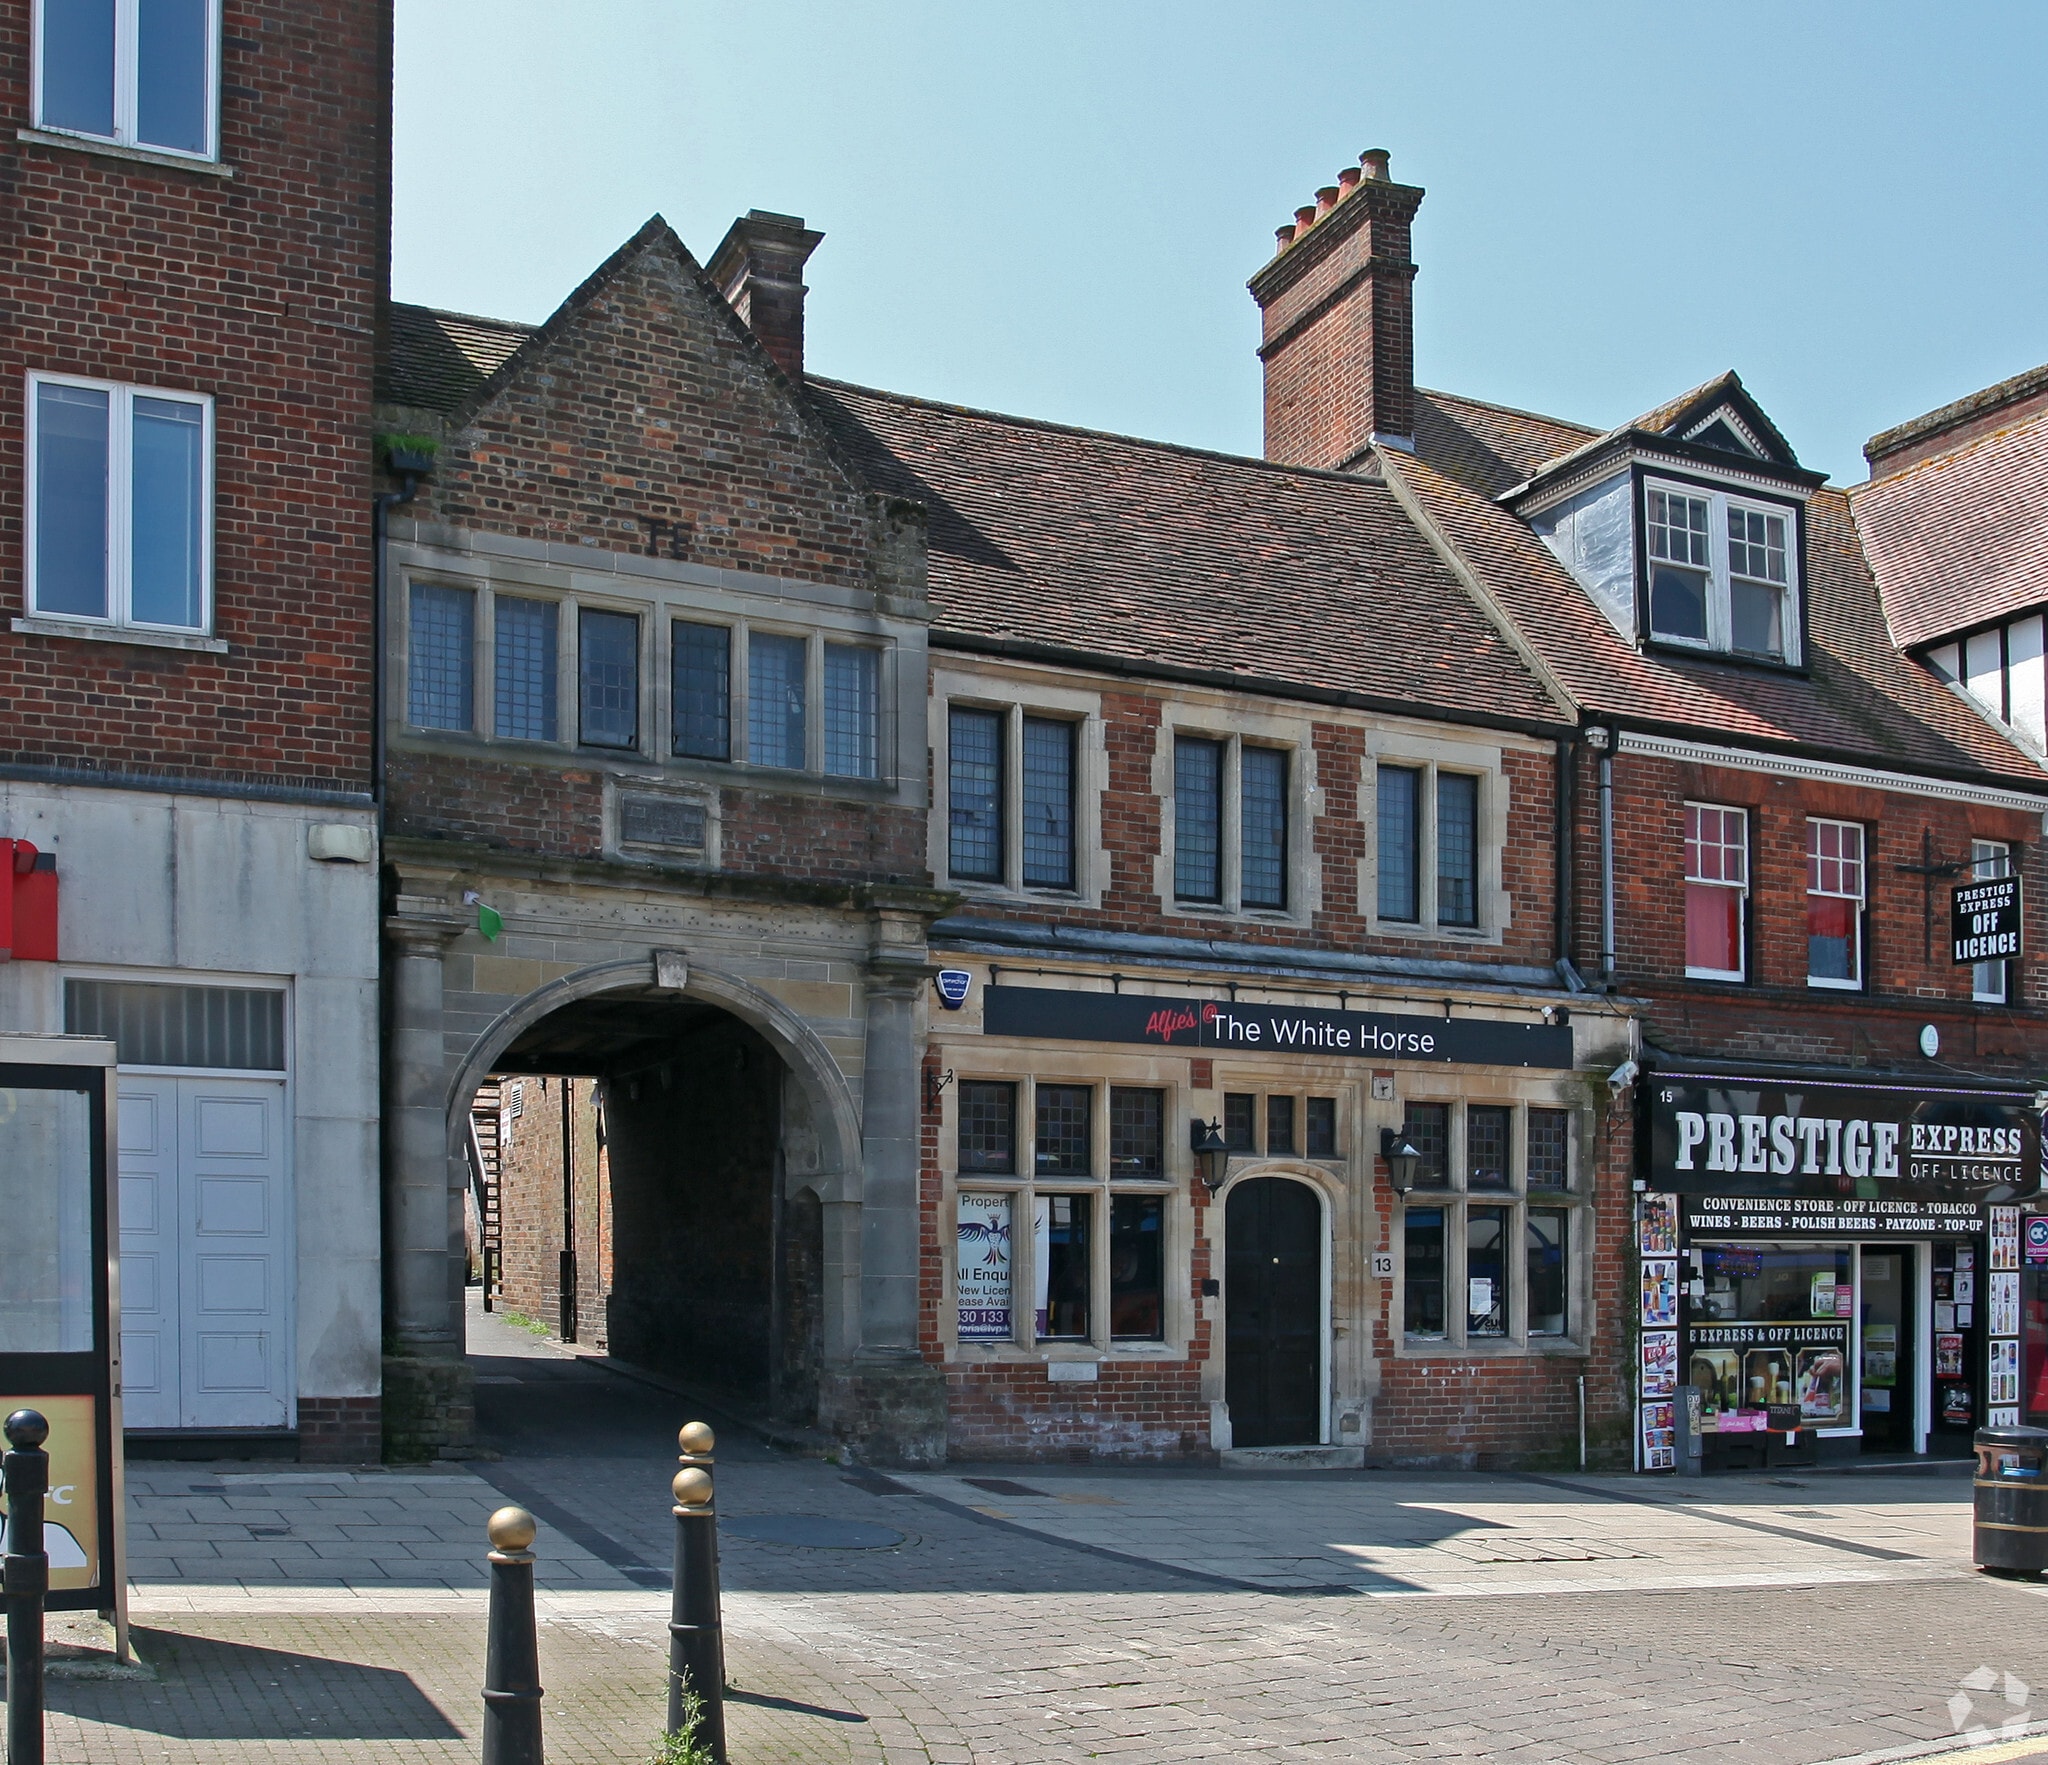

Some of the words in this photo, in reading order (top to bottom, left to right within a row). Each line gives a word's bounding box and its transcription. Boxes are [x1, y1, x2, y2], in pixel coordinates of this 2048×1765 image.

[1957, 883, 2014, 902] PRESTIGE
[1960, 896, 2010, 913] EXPRESS
[1972, 911, 1999, 935] OFF
[1955, 931, 2017, 960] LICENCE
[1145, 1005, 1198, 1042] Alfie's
[1211, 1014, 1261, 1042] The
[1270, 1018, 1351, 1048] White
[1360, 1024, 1435, 1053] Horse
[1660, 1091, 1673, 1103] 15
[1674, 1111, 1900, 1178] PRESTIGE
[1910, 1124, 2022, 1155] EXPRESS
[1910, 1163, 1940, 1178] OFF
[1951, 1165, 2022, 1182] LICENCE
[1703, 1197, 1791, 1212] CONVENIENCE
[1794, 1199, 1834, 1212] STORE
[1843, 1200, 1866, 1213] OFF
[1869, 1201, 1918, 1214] LICENCE
[1927, 1202, 1977, 1215] TOBACCO
[1690, 1214, 1731, 1228] WINES
[1741, 1216, 1782, 1229] BEERS
[1792, 1216, 1836, 1229] POLISH
[1838, 1217, 1877, 1230] BEERS
[1886, 1218, 1935, 1231] PAYZONE
[1944, 1219, 1983, 1231] TOP-UP
[1375, 1258, 1392, 1272] 13
[981, 1310, 1004, 1323] 133
[1700, 1328, 1754, 1343] EXPRESS
[1757, 1328, 1765, 1341] &
[1769, 1328, 1791, 1341] OFF
[1794, 1327, 1844, 1340] LICENCE
